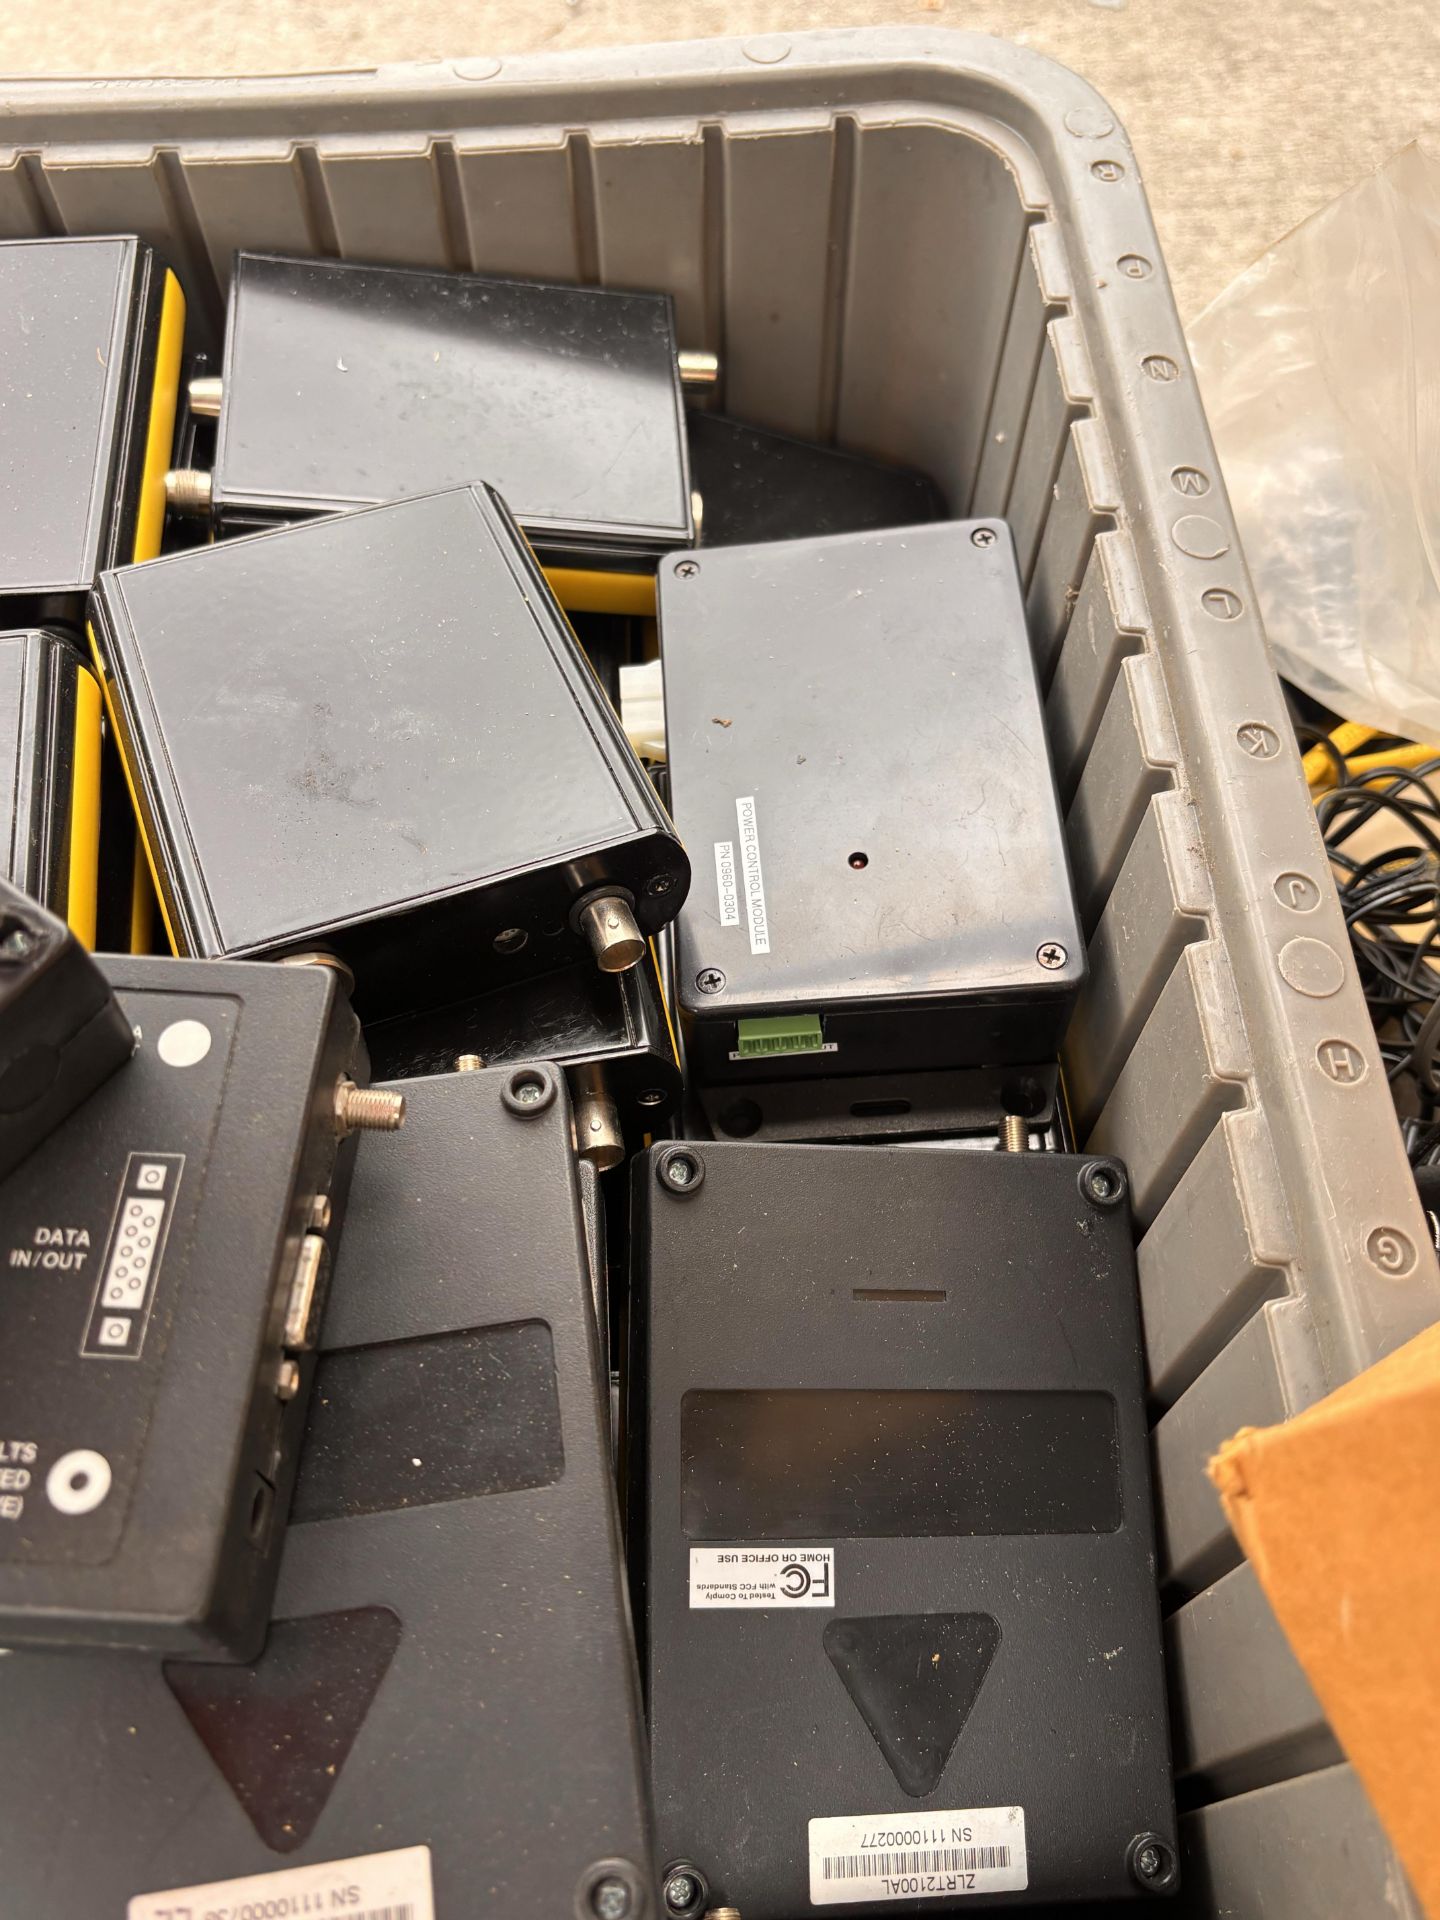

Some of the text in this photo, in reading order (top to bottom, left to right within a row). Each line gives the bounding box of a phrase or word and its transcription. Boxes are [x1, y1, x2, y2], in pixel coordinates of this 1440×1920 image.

[719, 844, 736, 920] PN 0960-0304
[741, 802, 767, 945] POWER CONTROL MODULE
[1326, 1047, 1355, 1078] H
[34, 1226, 91, 1248] DATA
[9, 1248, 87, 1271] IN/OUT
[1376, 1235, 1404, 1270] G
[717, 1553, 831, 1563] HOME OR OFFICE USE
[696, 1583, 738, 1591] Standards
[705, 1591, 776, 1600] Tested To Comply
[740, 1583, 757, 1591] FCC
[860, 1827, 973, 1848] SN 1110000277
[330, 1885, 361, 1905] SN
[881, 1873, 976, 1895] ZLRT2100AL
